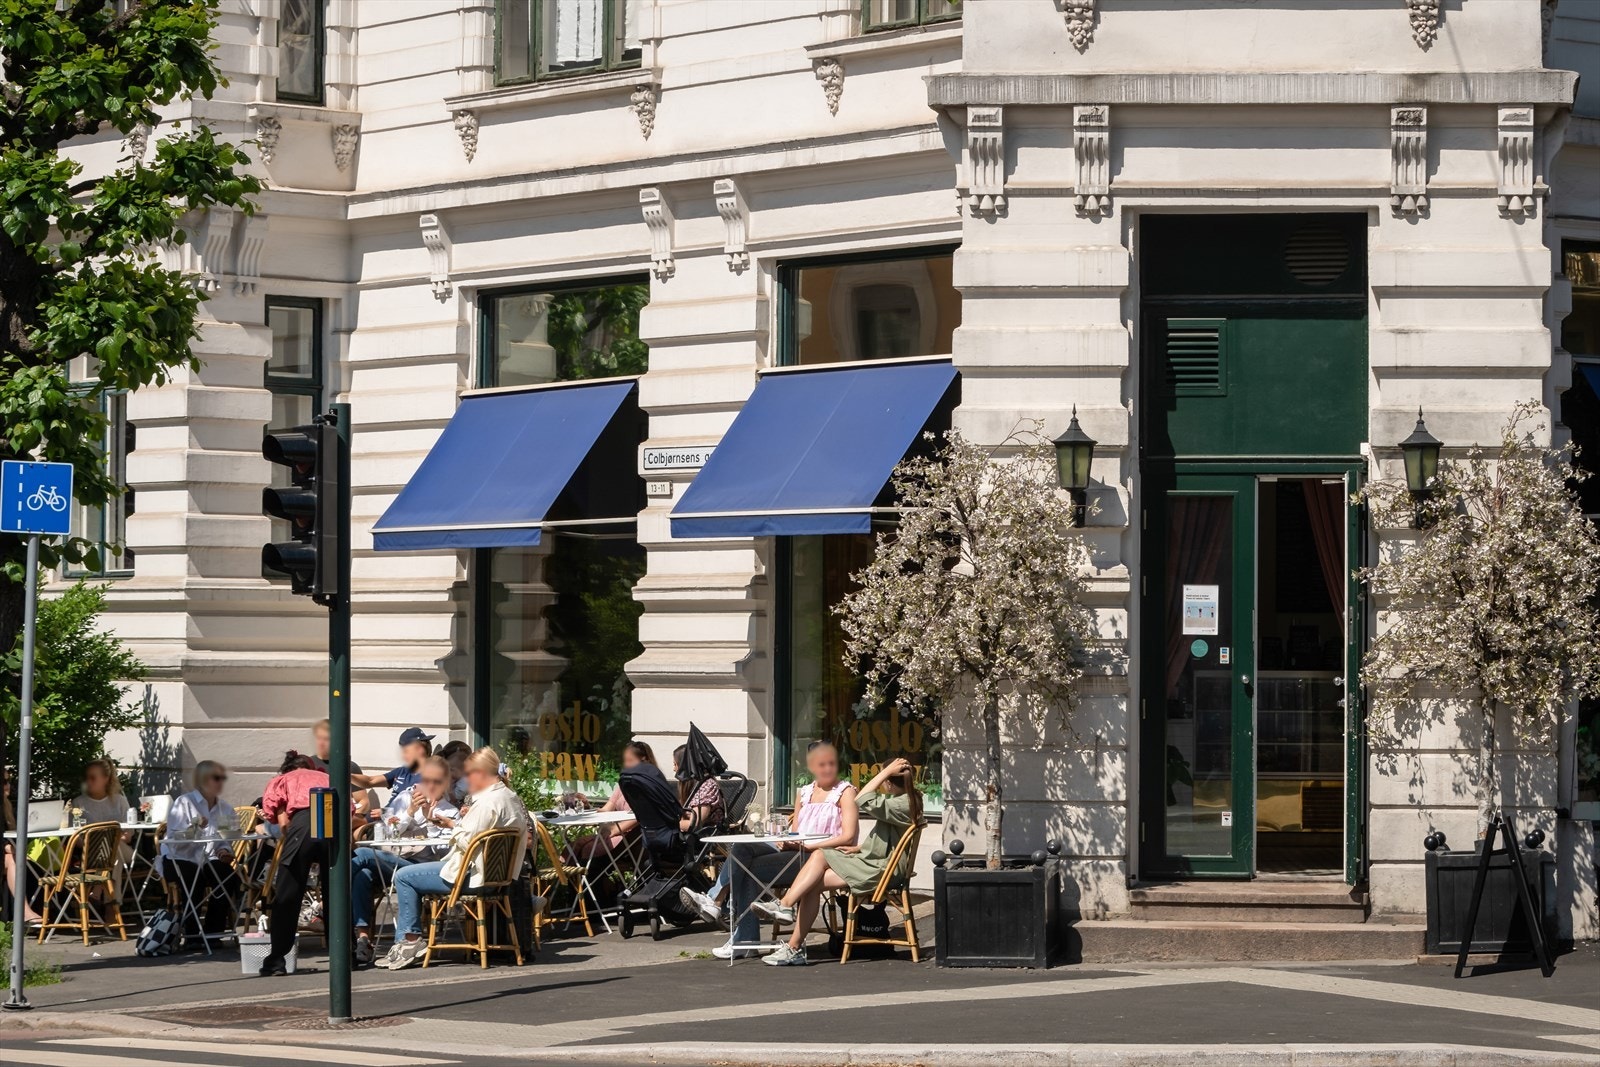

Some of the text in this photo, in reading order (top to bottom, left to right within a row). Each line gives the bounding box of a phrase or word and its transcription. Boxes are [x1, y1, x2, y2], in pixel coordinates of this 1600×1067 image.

[648, 453, 700, 466] Colbjørnsens
[539, 700, 600, 743] oslo
[850, 707, 923, 752] oslo
[539, 752, 600, 781] raw
